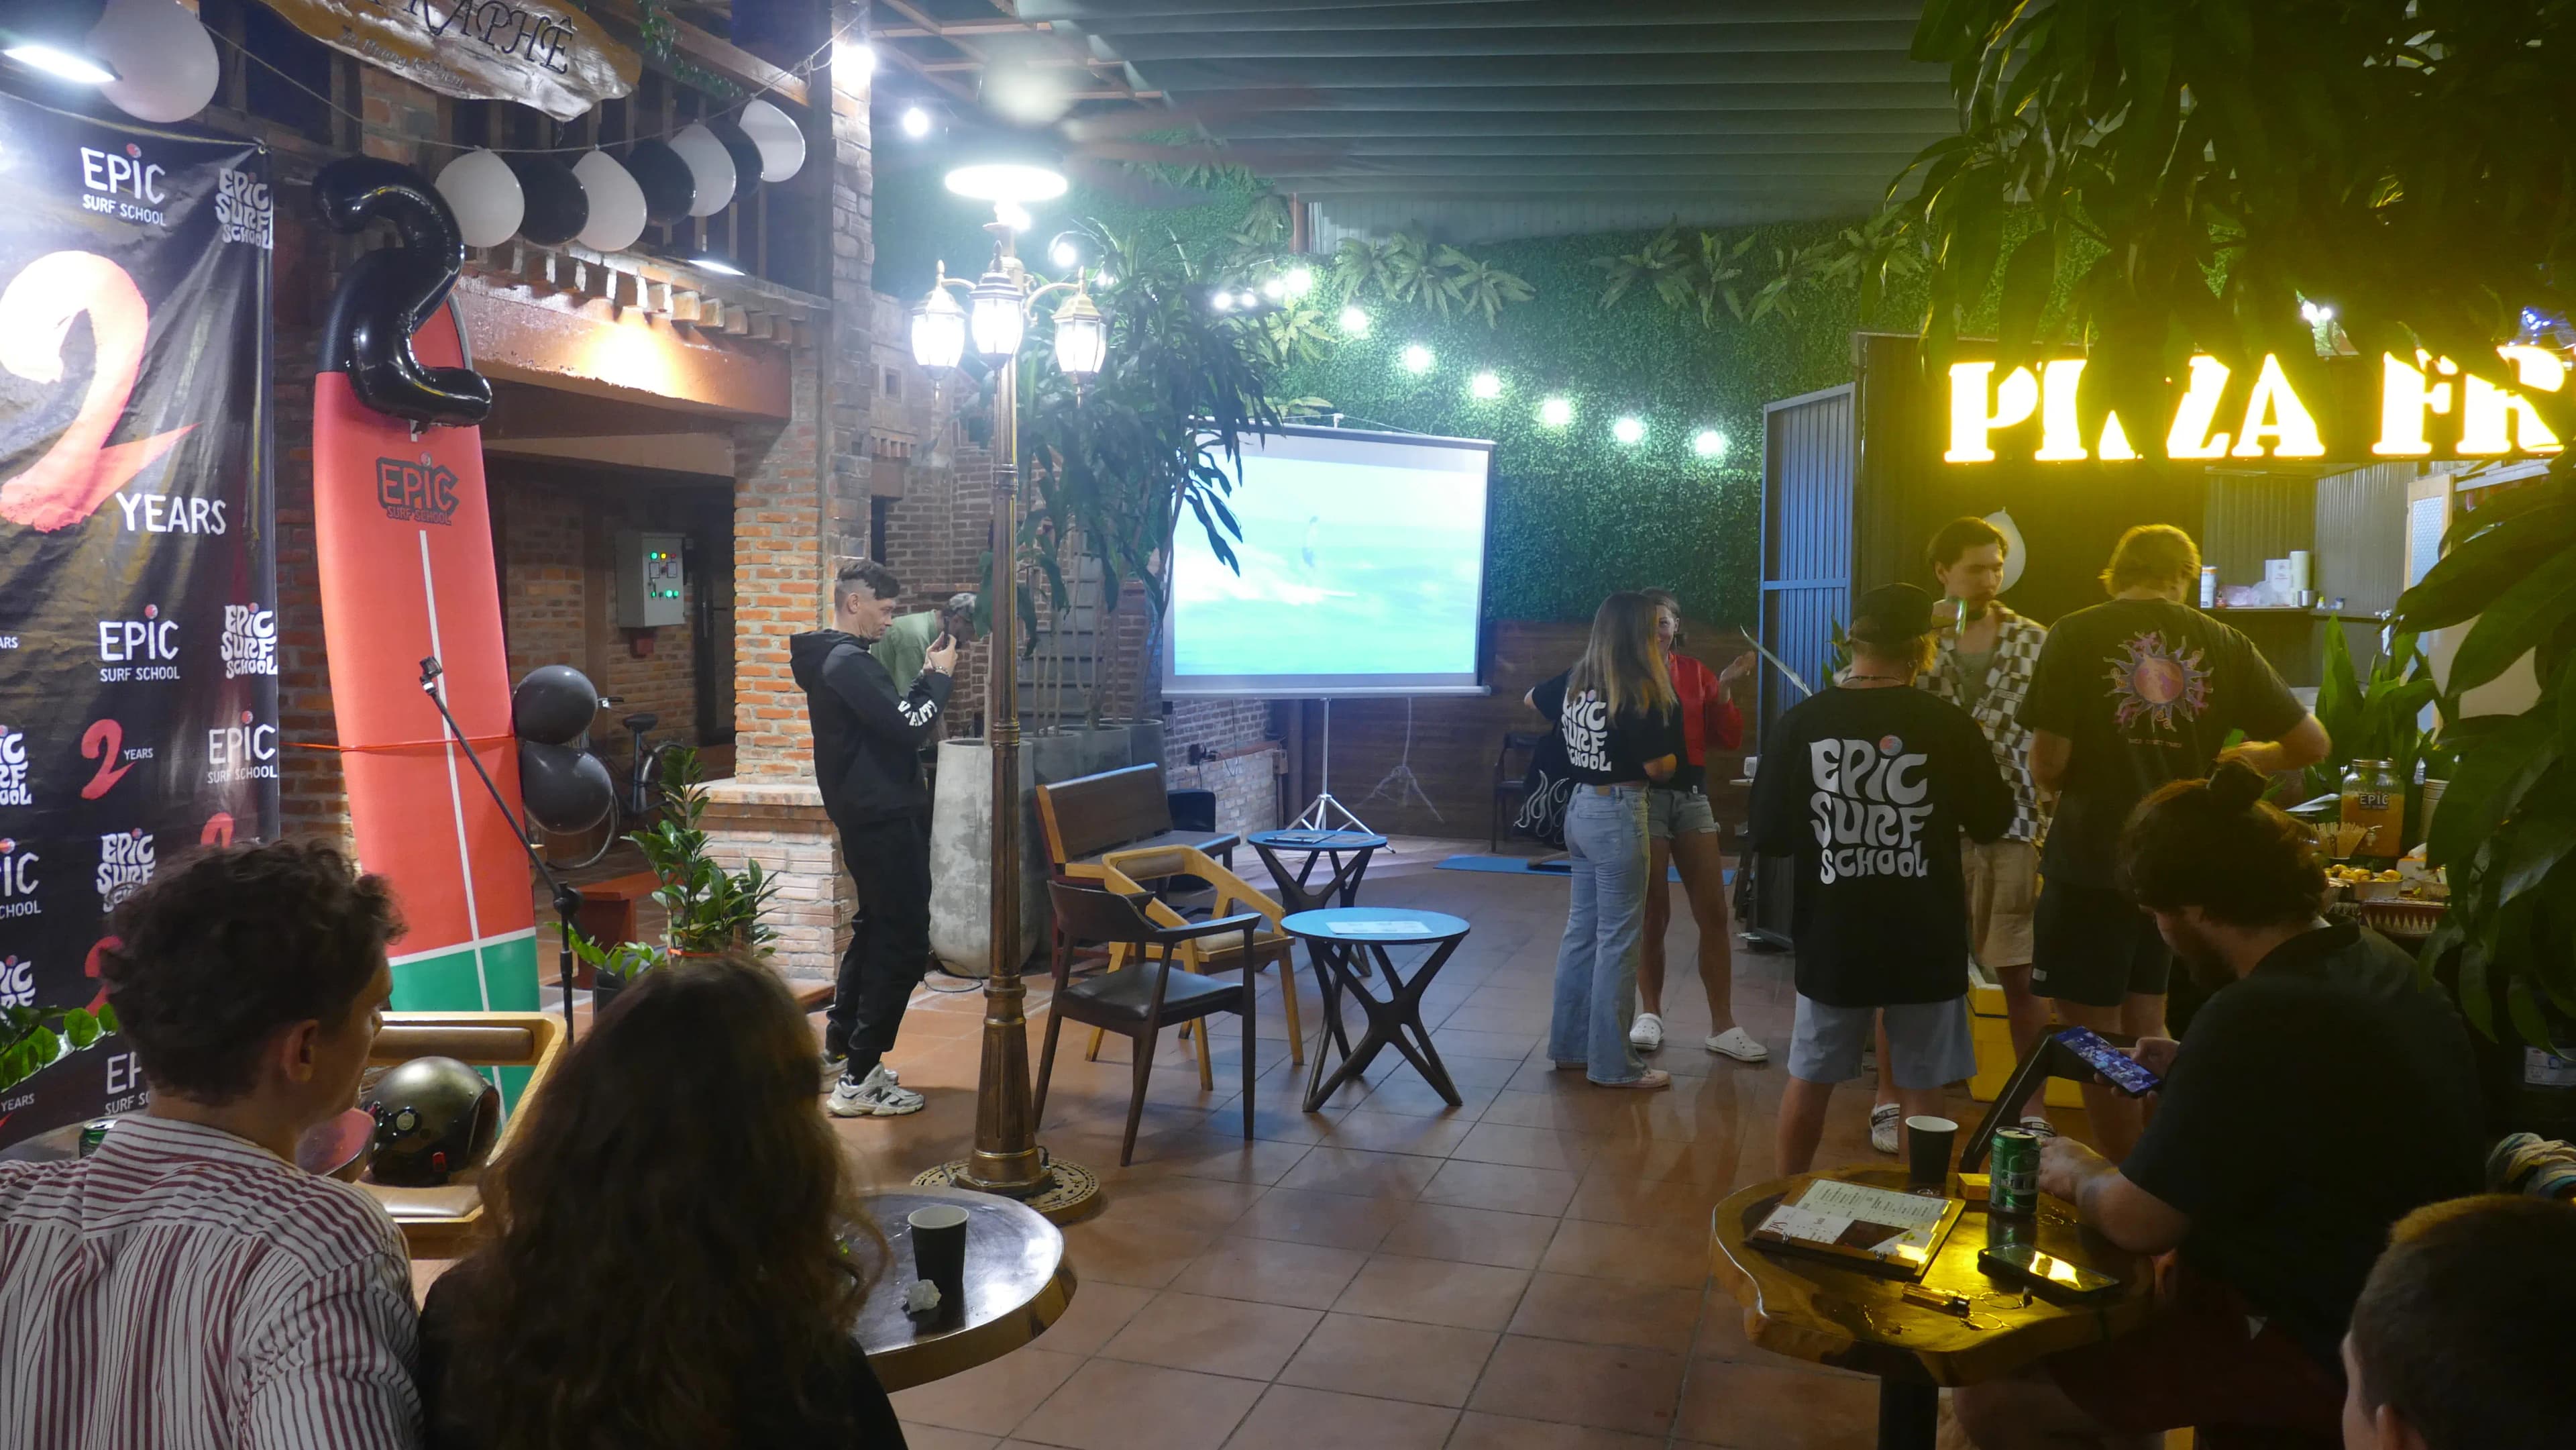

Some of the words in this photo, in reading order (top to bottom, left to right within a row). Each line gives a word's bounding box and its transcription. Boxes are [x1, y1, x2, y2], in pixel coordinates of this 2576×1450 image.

[83, 193, 116, 213] SURF
[120, 203, 167, 227] SCHOOL
[215, 193, 273, 233] SURF
[223, 223, 273, 250] SCHOOL
[1943, 352, 2327, 463] PIZA
[115, 493, 227, 535] YEARS
[387, 506, 412, 521] SURF
[414, 509, 452, 527] SCHOOL
[0, 636, 18, 649] ARS
[221, 635, 277, 662] SURF
[100, 669, 131, 682] SURF
[136, 666, 180, 681] SCHOOL
[225, 655, 278, 679] SCHOOL
[81, 719, 138, 800] 2
[123, 748, 154, 760] YEARS
[207, 770, 232, 784] SURF
[234, 765, 278, 780] SCHOOL
[1809, 791, 1934, 849] SURF
[1820, 840, 1929, 885] SCHOOL
[96, 860, 156, 894] SURF
[0, 900, 42, 920] CHOOL
[1, 1093, 35, 1112] YEARS
[104, 1094, 135, 1116] SURF
